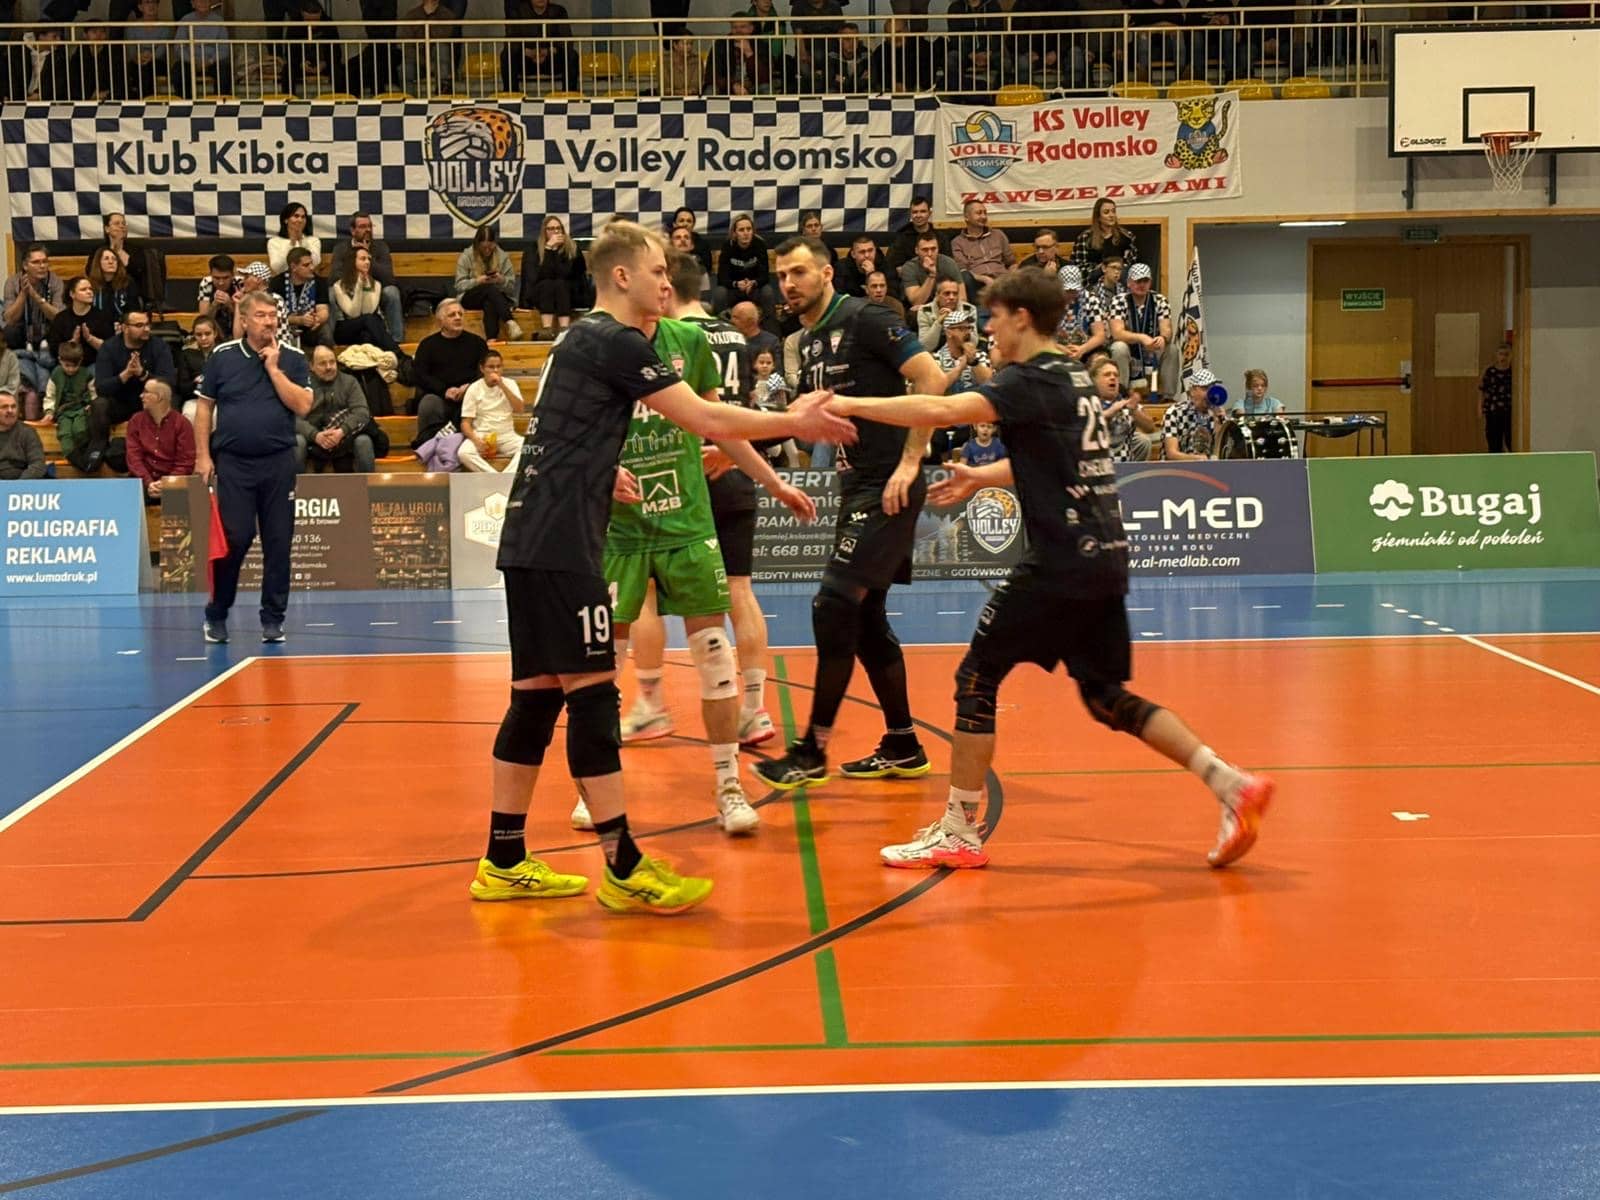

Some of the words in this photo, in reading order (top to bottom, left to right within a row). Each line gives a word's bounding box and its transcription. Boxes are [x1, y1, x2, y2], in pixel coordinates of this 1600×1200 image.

[1033, 109, 1065, 132] KS
[1072, 106, 1150, 131] Volley
[106, 140, 197, 176] Klub
[208, 140, 329, 175] Kibica
[565, 137, 686, 182] Volley
[698, 134, 898, 172] Radomsko
[950, 143, 1021, 157] VOLLEY
[1027, 135, 1158, 164] Radomsko
[430, 160, 520, 193] VOLLEY
[961, 186, 1098, 205] ZAWSZE
[1103, 184, 1125, 199] Z
[1129, 176, 1227, 197] WAMI
[8, 493, 62, 511] DRUK
[295, 498, 340, 517] RGIA
[642, 496, 682, 515] MZB
[1418, 483, 1542, 526] Bugaj
[7, 519, 119, 538] POLIGRAFIA
[972, 518, 1018, 535] VOLLEY
[304, 534, 321, 543] 136
[1187, 533, 1251, 541] MEDYCZNE
[1371, 531, 1454, 553] ziemniaki
[1457, 529, 1480, 546] od
[1479, 528, 1544, 550] pokoleń
[6, 546, 97, 565] REKLAMA
[772, 545, 799, 556] 668
[803, 544, 826, 556] 831
[1182, 543, 1214, 551] ROKU
[1128, 554, 1241, 569] w.al-medlab.com
[752, 571, 790, 580] REDYTY
[577, 604, 610, 644] 19
